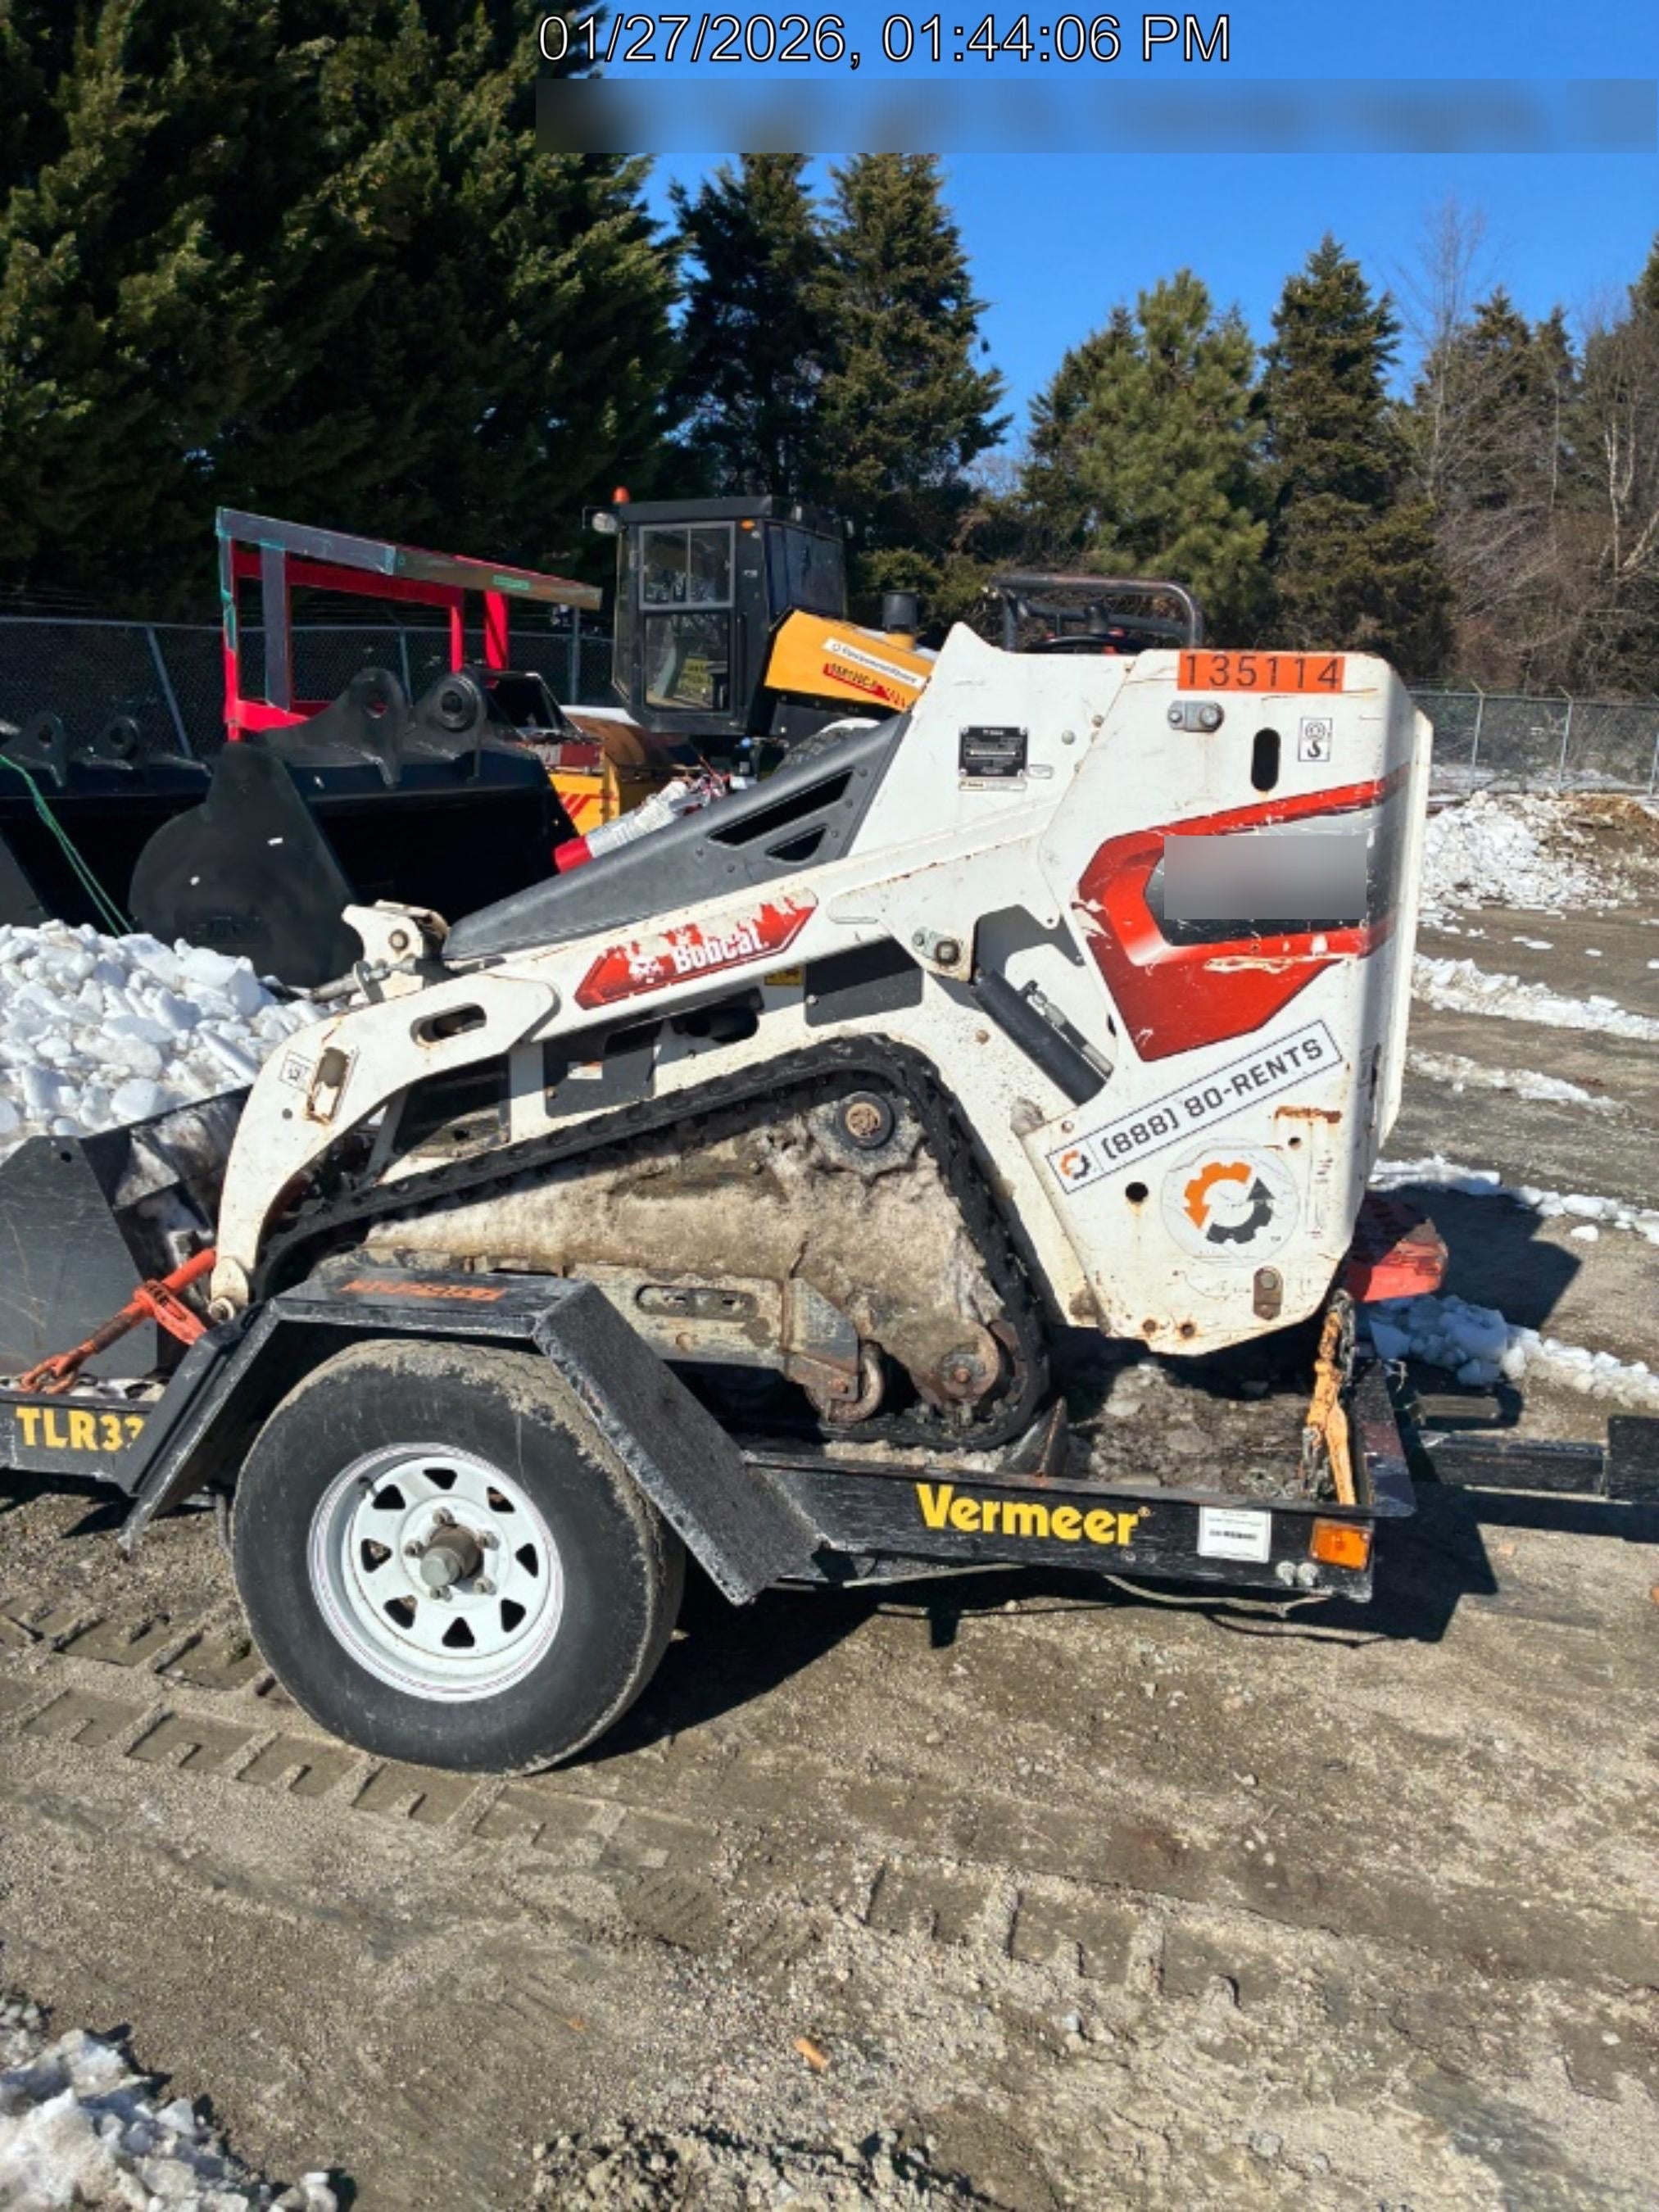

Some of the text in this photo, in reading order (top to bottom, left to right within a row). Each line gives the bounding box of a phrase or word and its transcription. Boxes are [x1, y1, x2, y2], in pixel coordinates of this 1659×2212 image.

[1186, 655, 1338, 689] 135114
[673, 919, 764, 974] Bobcat
[1100, 1038, 1323, 1159] (888) 80-RENTS
[915, 1483, 1140, 1546] Vermeer
